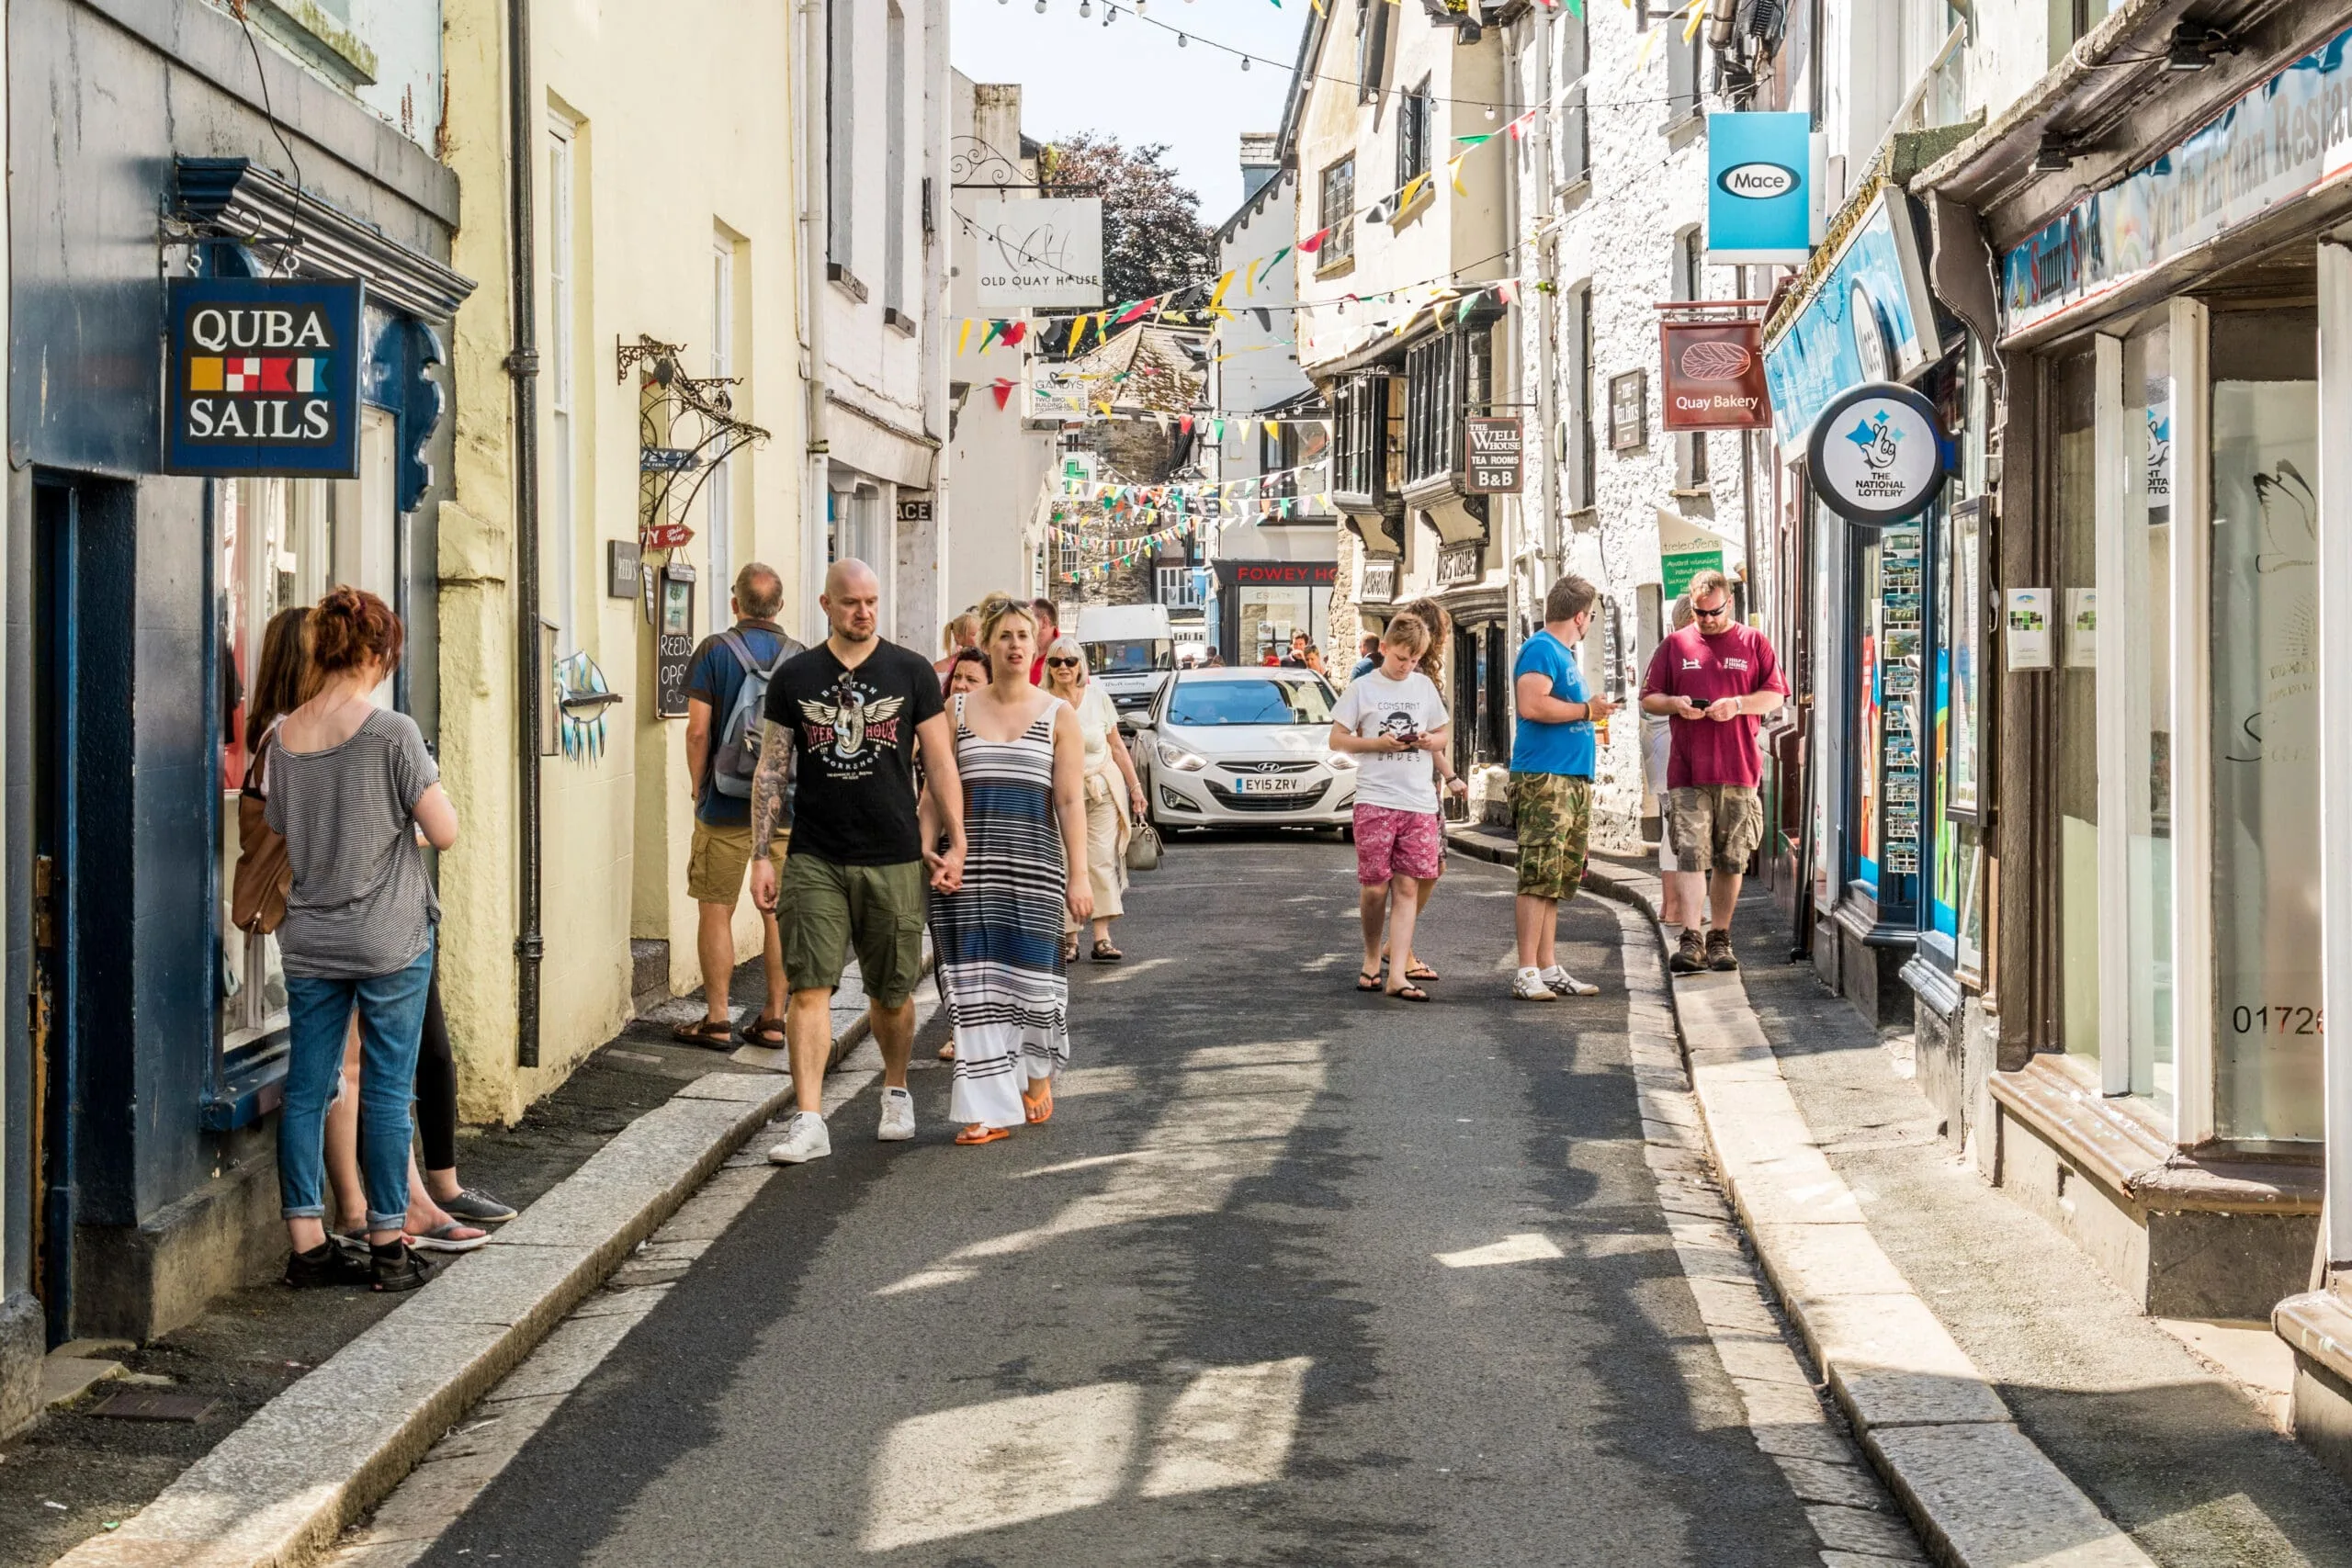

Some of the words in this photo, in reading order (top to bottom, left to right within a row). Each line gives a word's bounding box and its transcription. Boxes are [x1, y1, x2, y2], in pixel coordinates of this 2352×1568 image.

[1734, 173, 1785, 188] Mace
[981, 277, 1006, 286] OLD
[1012, 276, 1049, 289] QUAY
[192, 309, 330, 352] QUBA
[1676, 396, 1711, 411] Quay
[1713, 394, 1758, 410] Bakery
[190, 399, 329, 439] SAILS
[1469, 430, 1521, 450] WELL
[1489, 442, 1521, 450] HOUSE
[1471, 457, 1487, 465] TEA
[1490, 457, 1519, 465] ROOMS
[1478, 471, 1513, 486] B&B
[1856, 480, 1905, 489] NATIONAL
[1664, 539, 1719, 551] treleavens
[1238, 567, 1308, 581] FOWEY
[661, 635, 693, 657] REED'S
[662, 664, 687, 686] OPE
[1377, 702, 1420, 711] CONSTANT
[1246, 779, 1272, 790] EY15
[1275, 779, 1297, 790] ZRV
